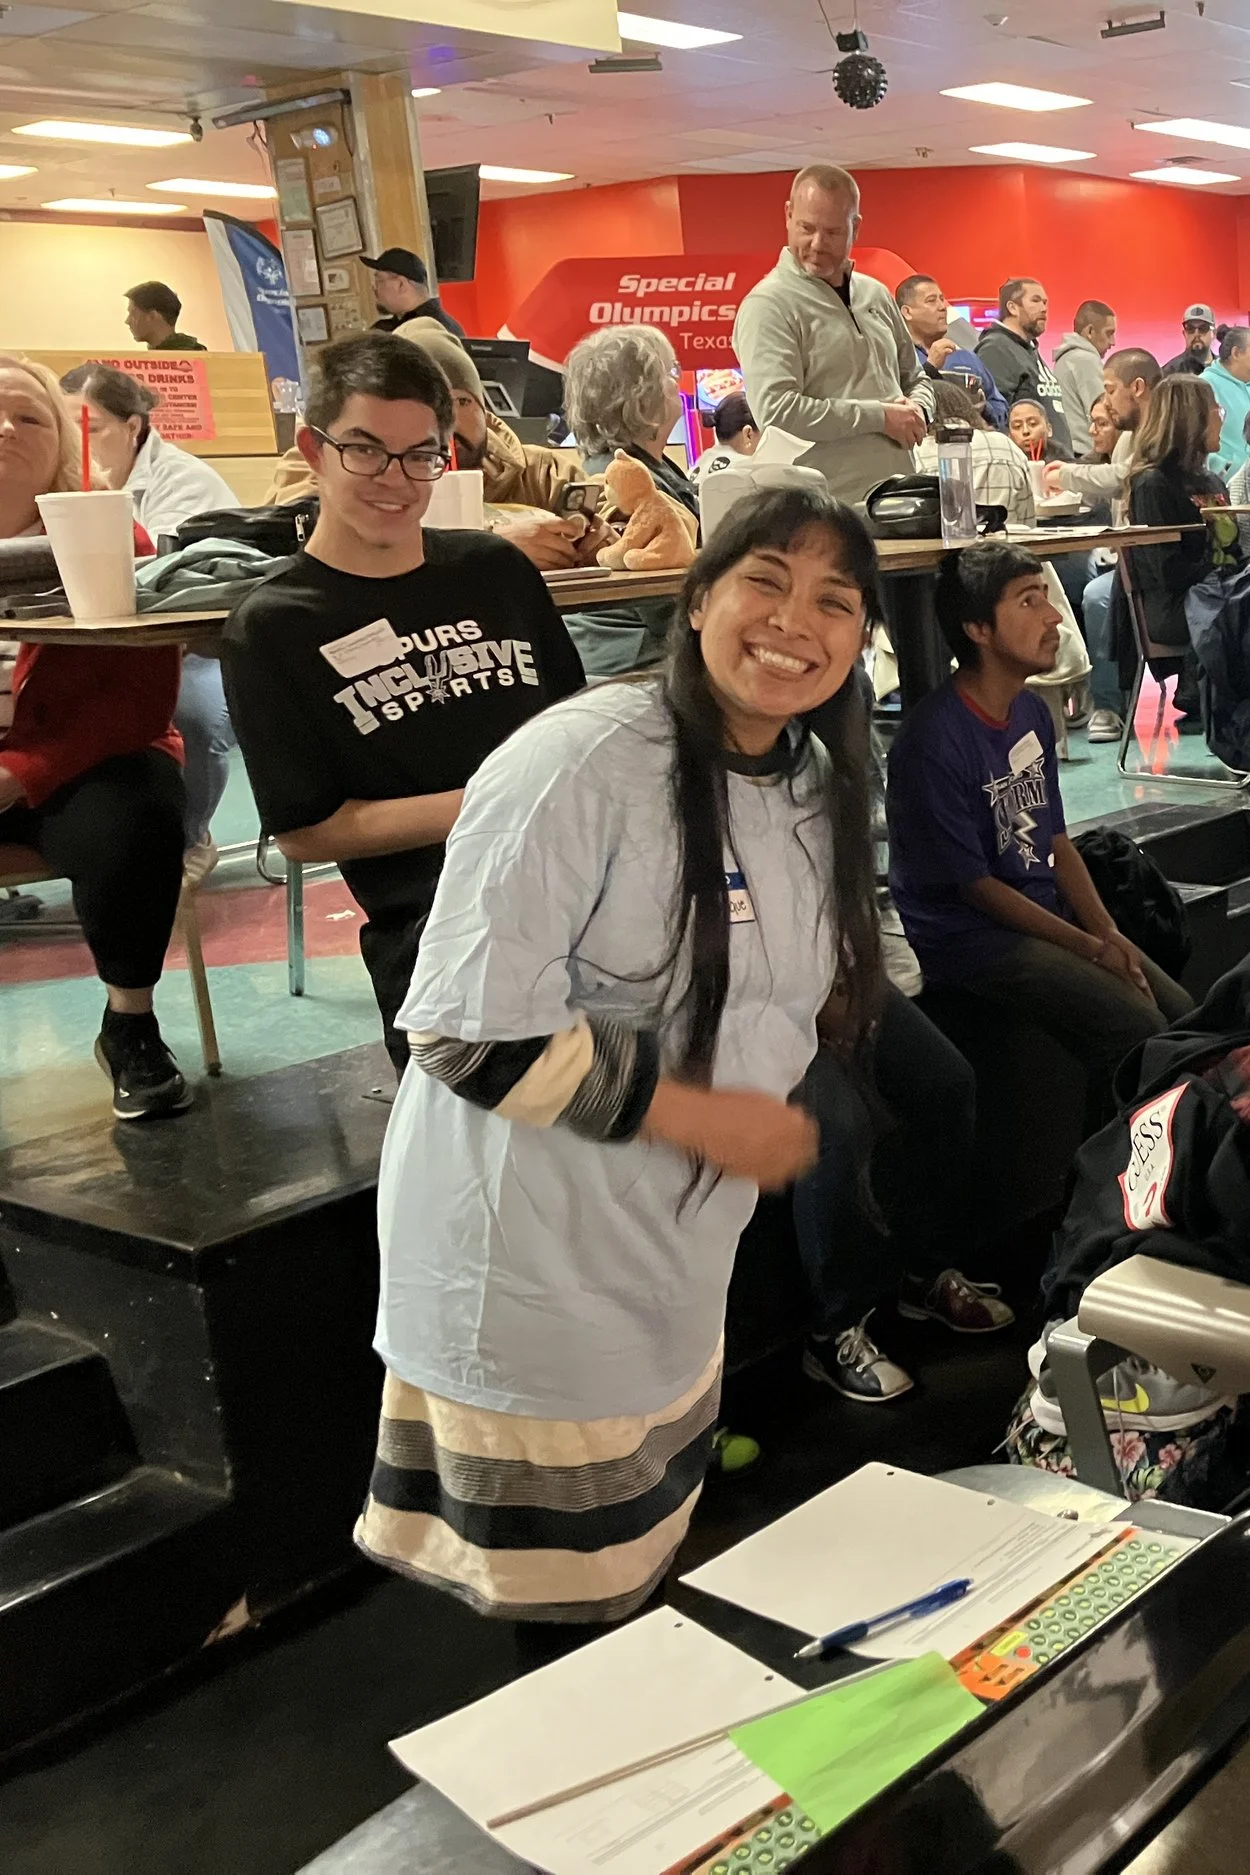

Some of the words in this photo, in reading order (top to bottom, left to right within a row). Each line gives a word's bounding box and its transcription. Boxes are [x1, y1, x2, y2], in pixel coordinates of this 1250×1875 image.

[617, 272, 736, 298] Special
[589, 300, 737, 327] Olympics
[123, 360, 178, 370] OUTSIDE
[148, 374, 195, 384] DRINKS
[396, 619, 483, 660] PURS
[333, 639, 539, 735] INCLUSIVE
